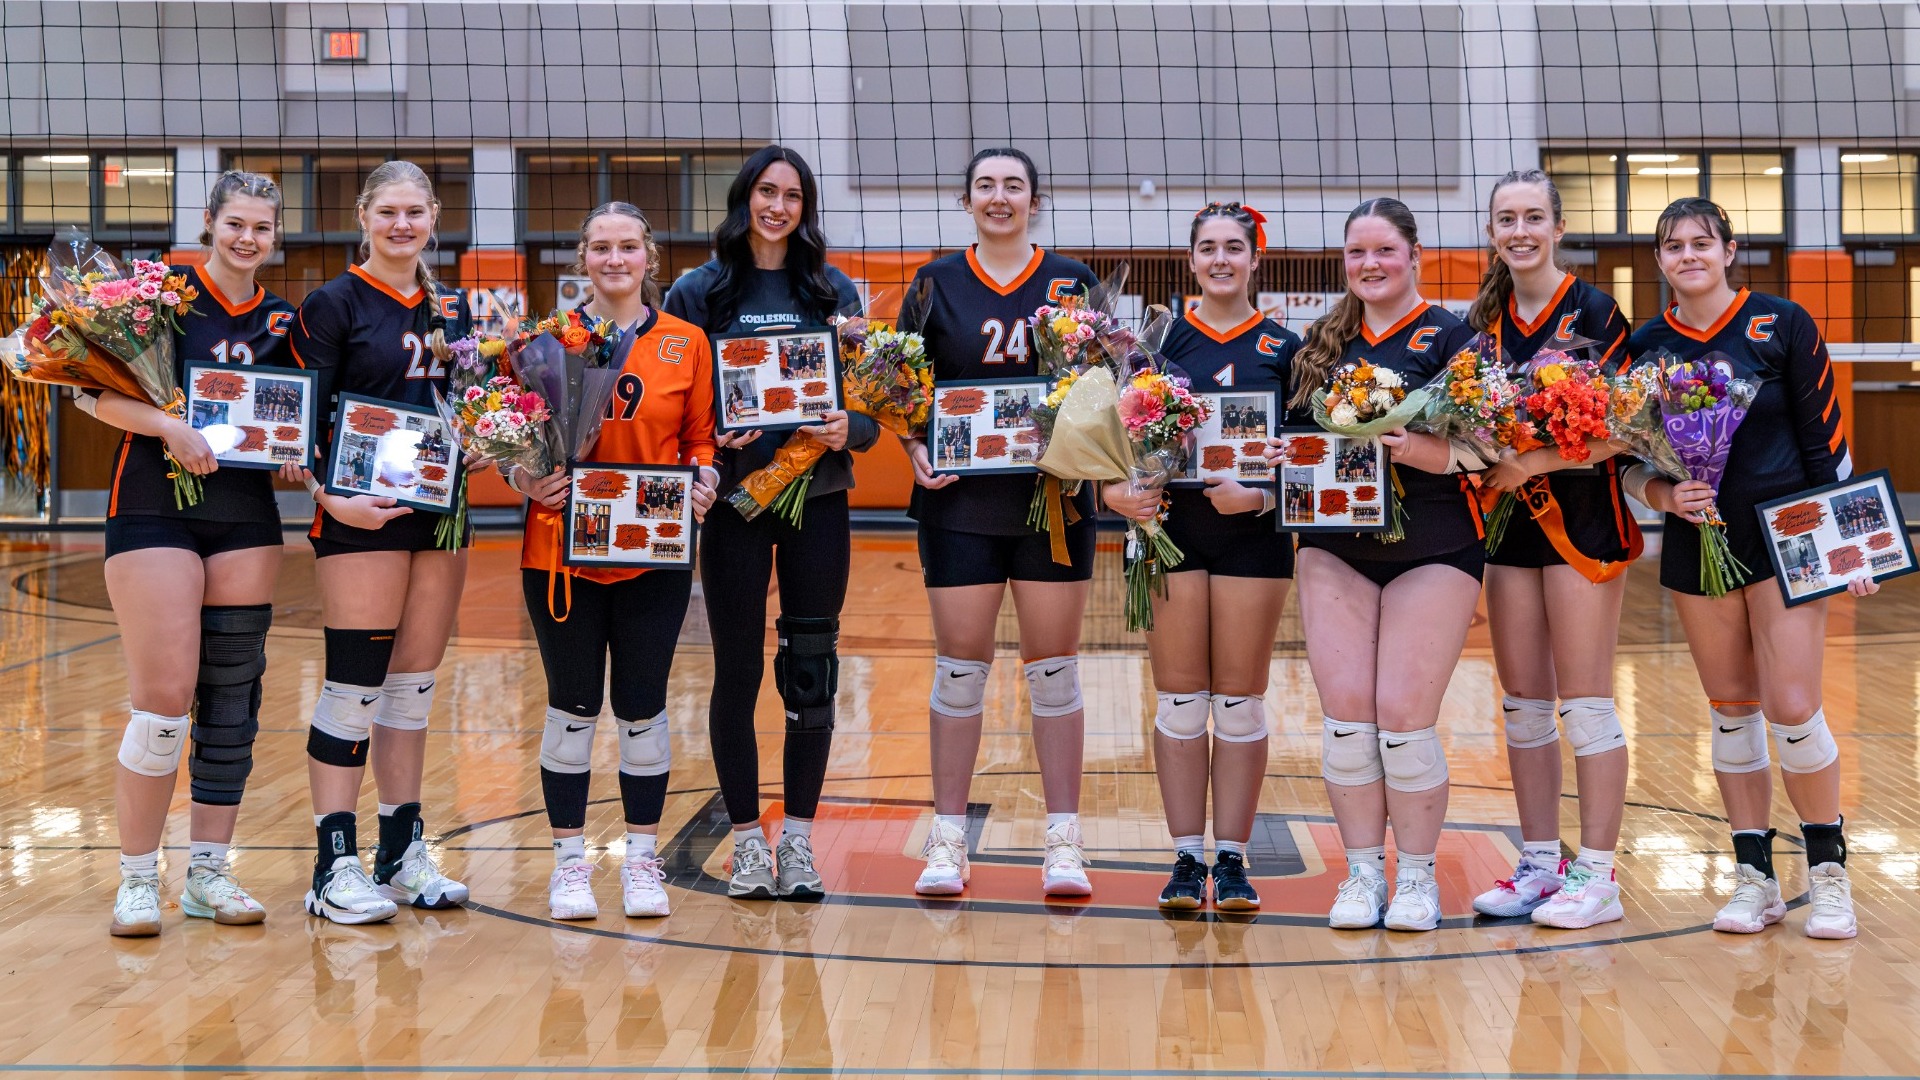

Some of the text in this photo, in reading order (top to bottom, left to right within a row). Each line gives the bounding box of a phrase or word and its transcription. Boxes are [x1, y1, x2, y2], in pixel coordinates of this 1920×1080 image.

[739, 313, 802, 324] COBLESKILL
[981, 318, 1030, 364] 24
[402, 331, 446, 379] 22
